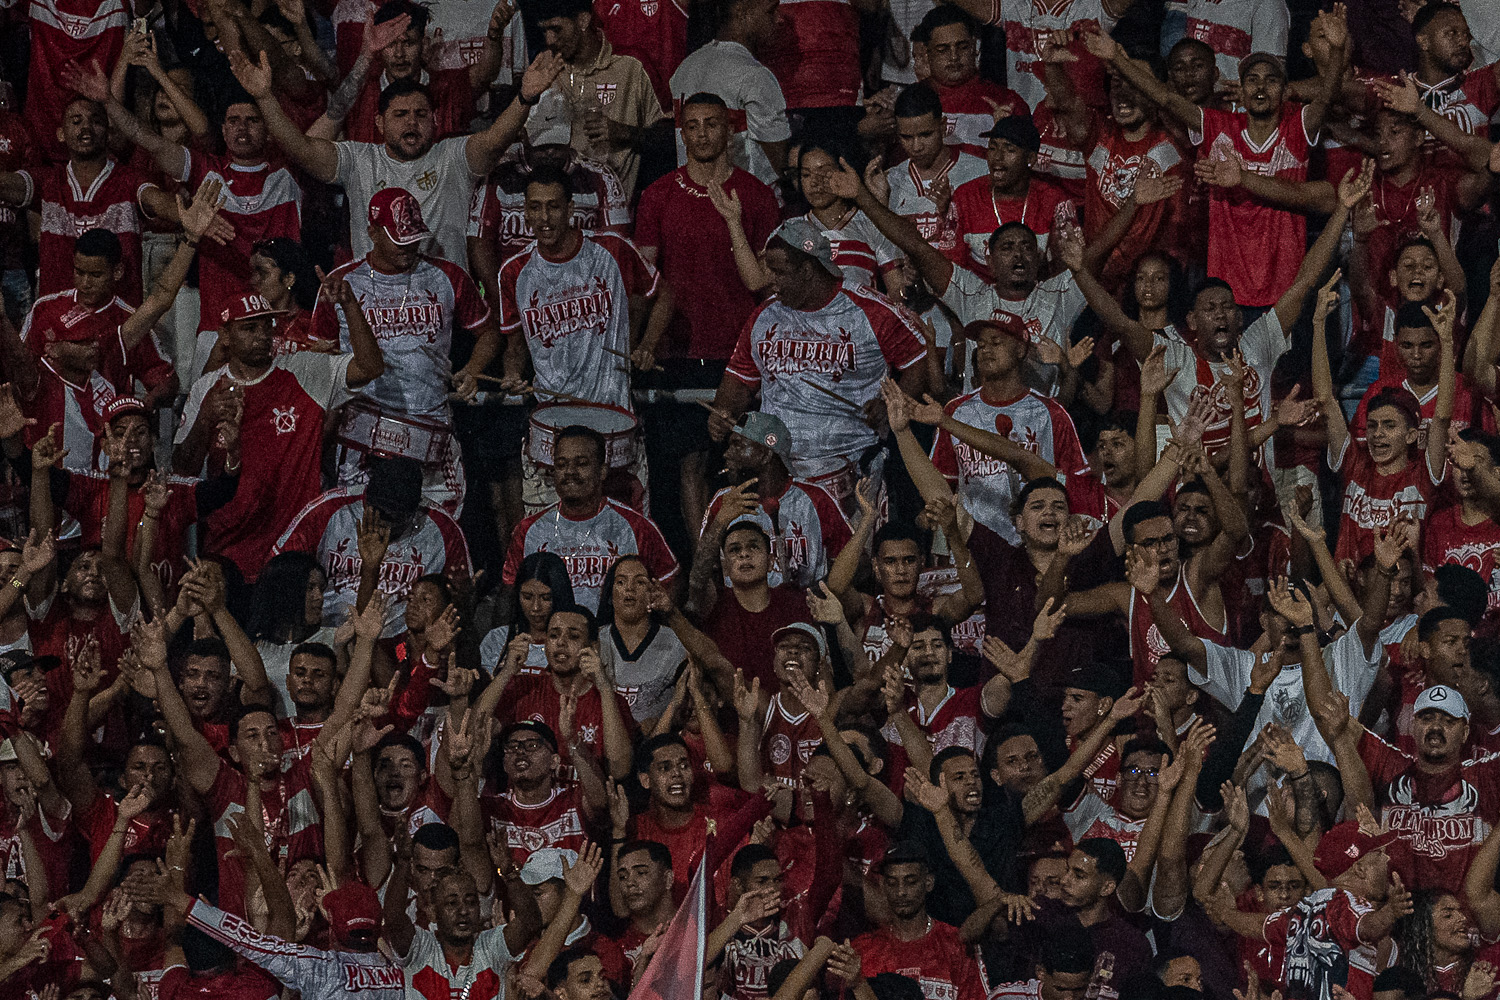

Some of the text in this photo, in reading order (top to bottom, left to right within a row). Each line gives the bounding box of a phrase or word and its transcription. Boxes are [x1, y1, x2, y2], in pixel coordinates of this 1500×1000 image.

[365, 303, 442, 329] ATERIA
[523, 289, 611, 338] BATERIA
[370, 321, 441, 340] LINDADA
[758, 329, 856, 368] BATERIA
